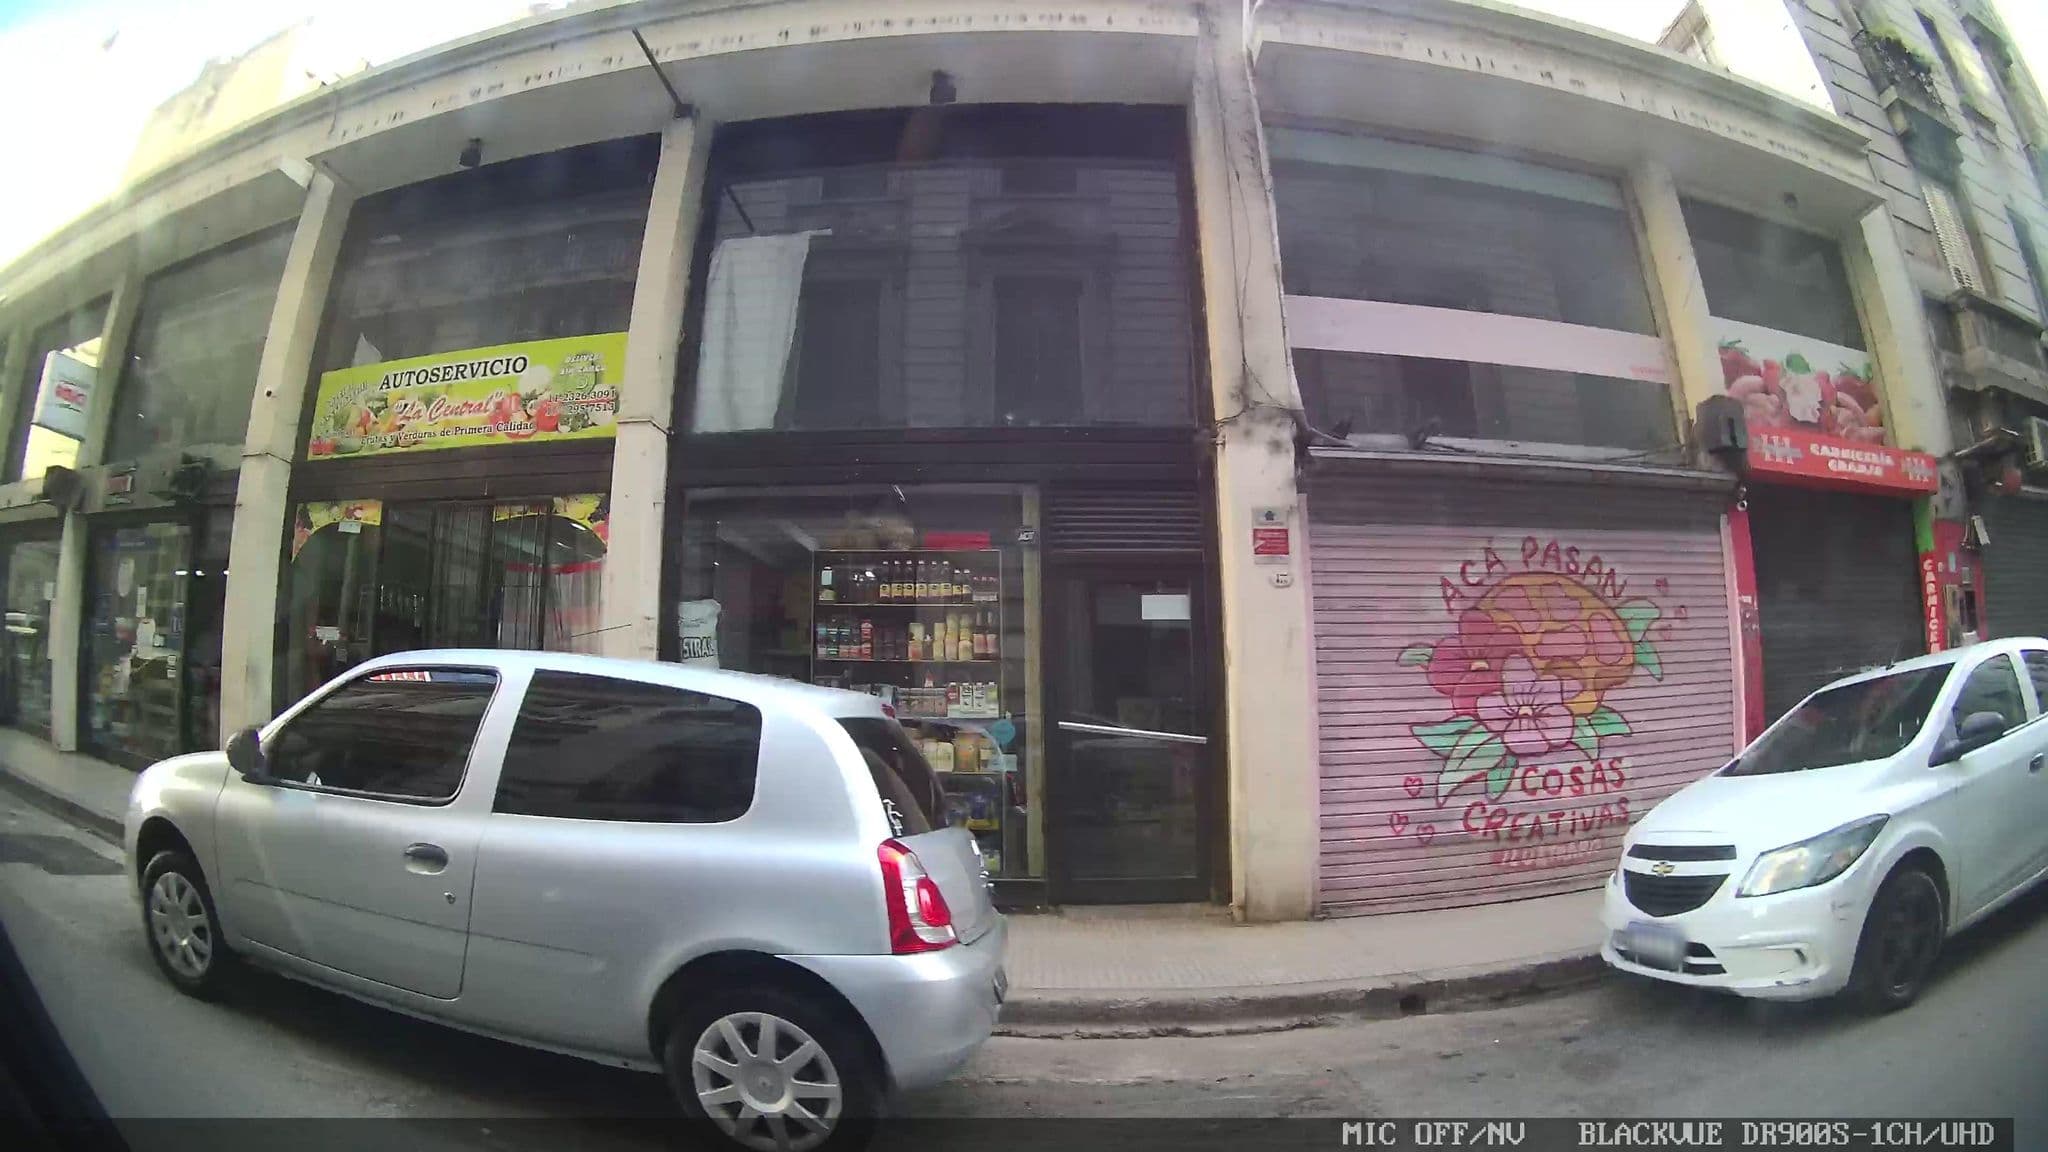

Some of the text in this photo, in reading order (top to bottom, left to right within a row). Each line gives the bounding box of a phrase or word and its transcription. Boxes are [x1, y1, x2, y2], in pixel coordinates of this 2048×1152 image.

[379, 356, 528, 391] AUTOSERVICIO
[440, 428, 451, 437] de
[454, 424, 493, 437] Primera
[1521, 535, 1628, 599] PASAN
[1521, 758, 1626, 797] COSAS
[1463, 797, 1630, 842] CREATIVAS
